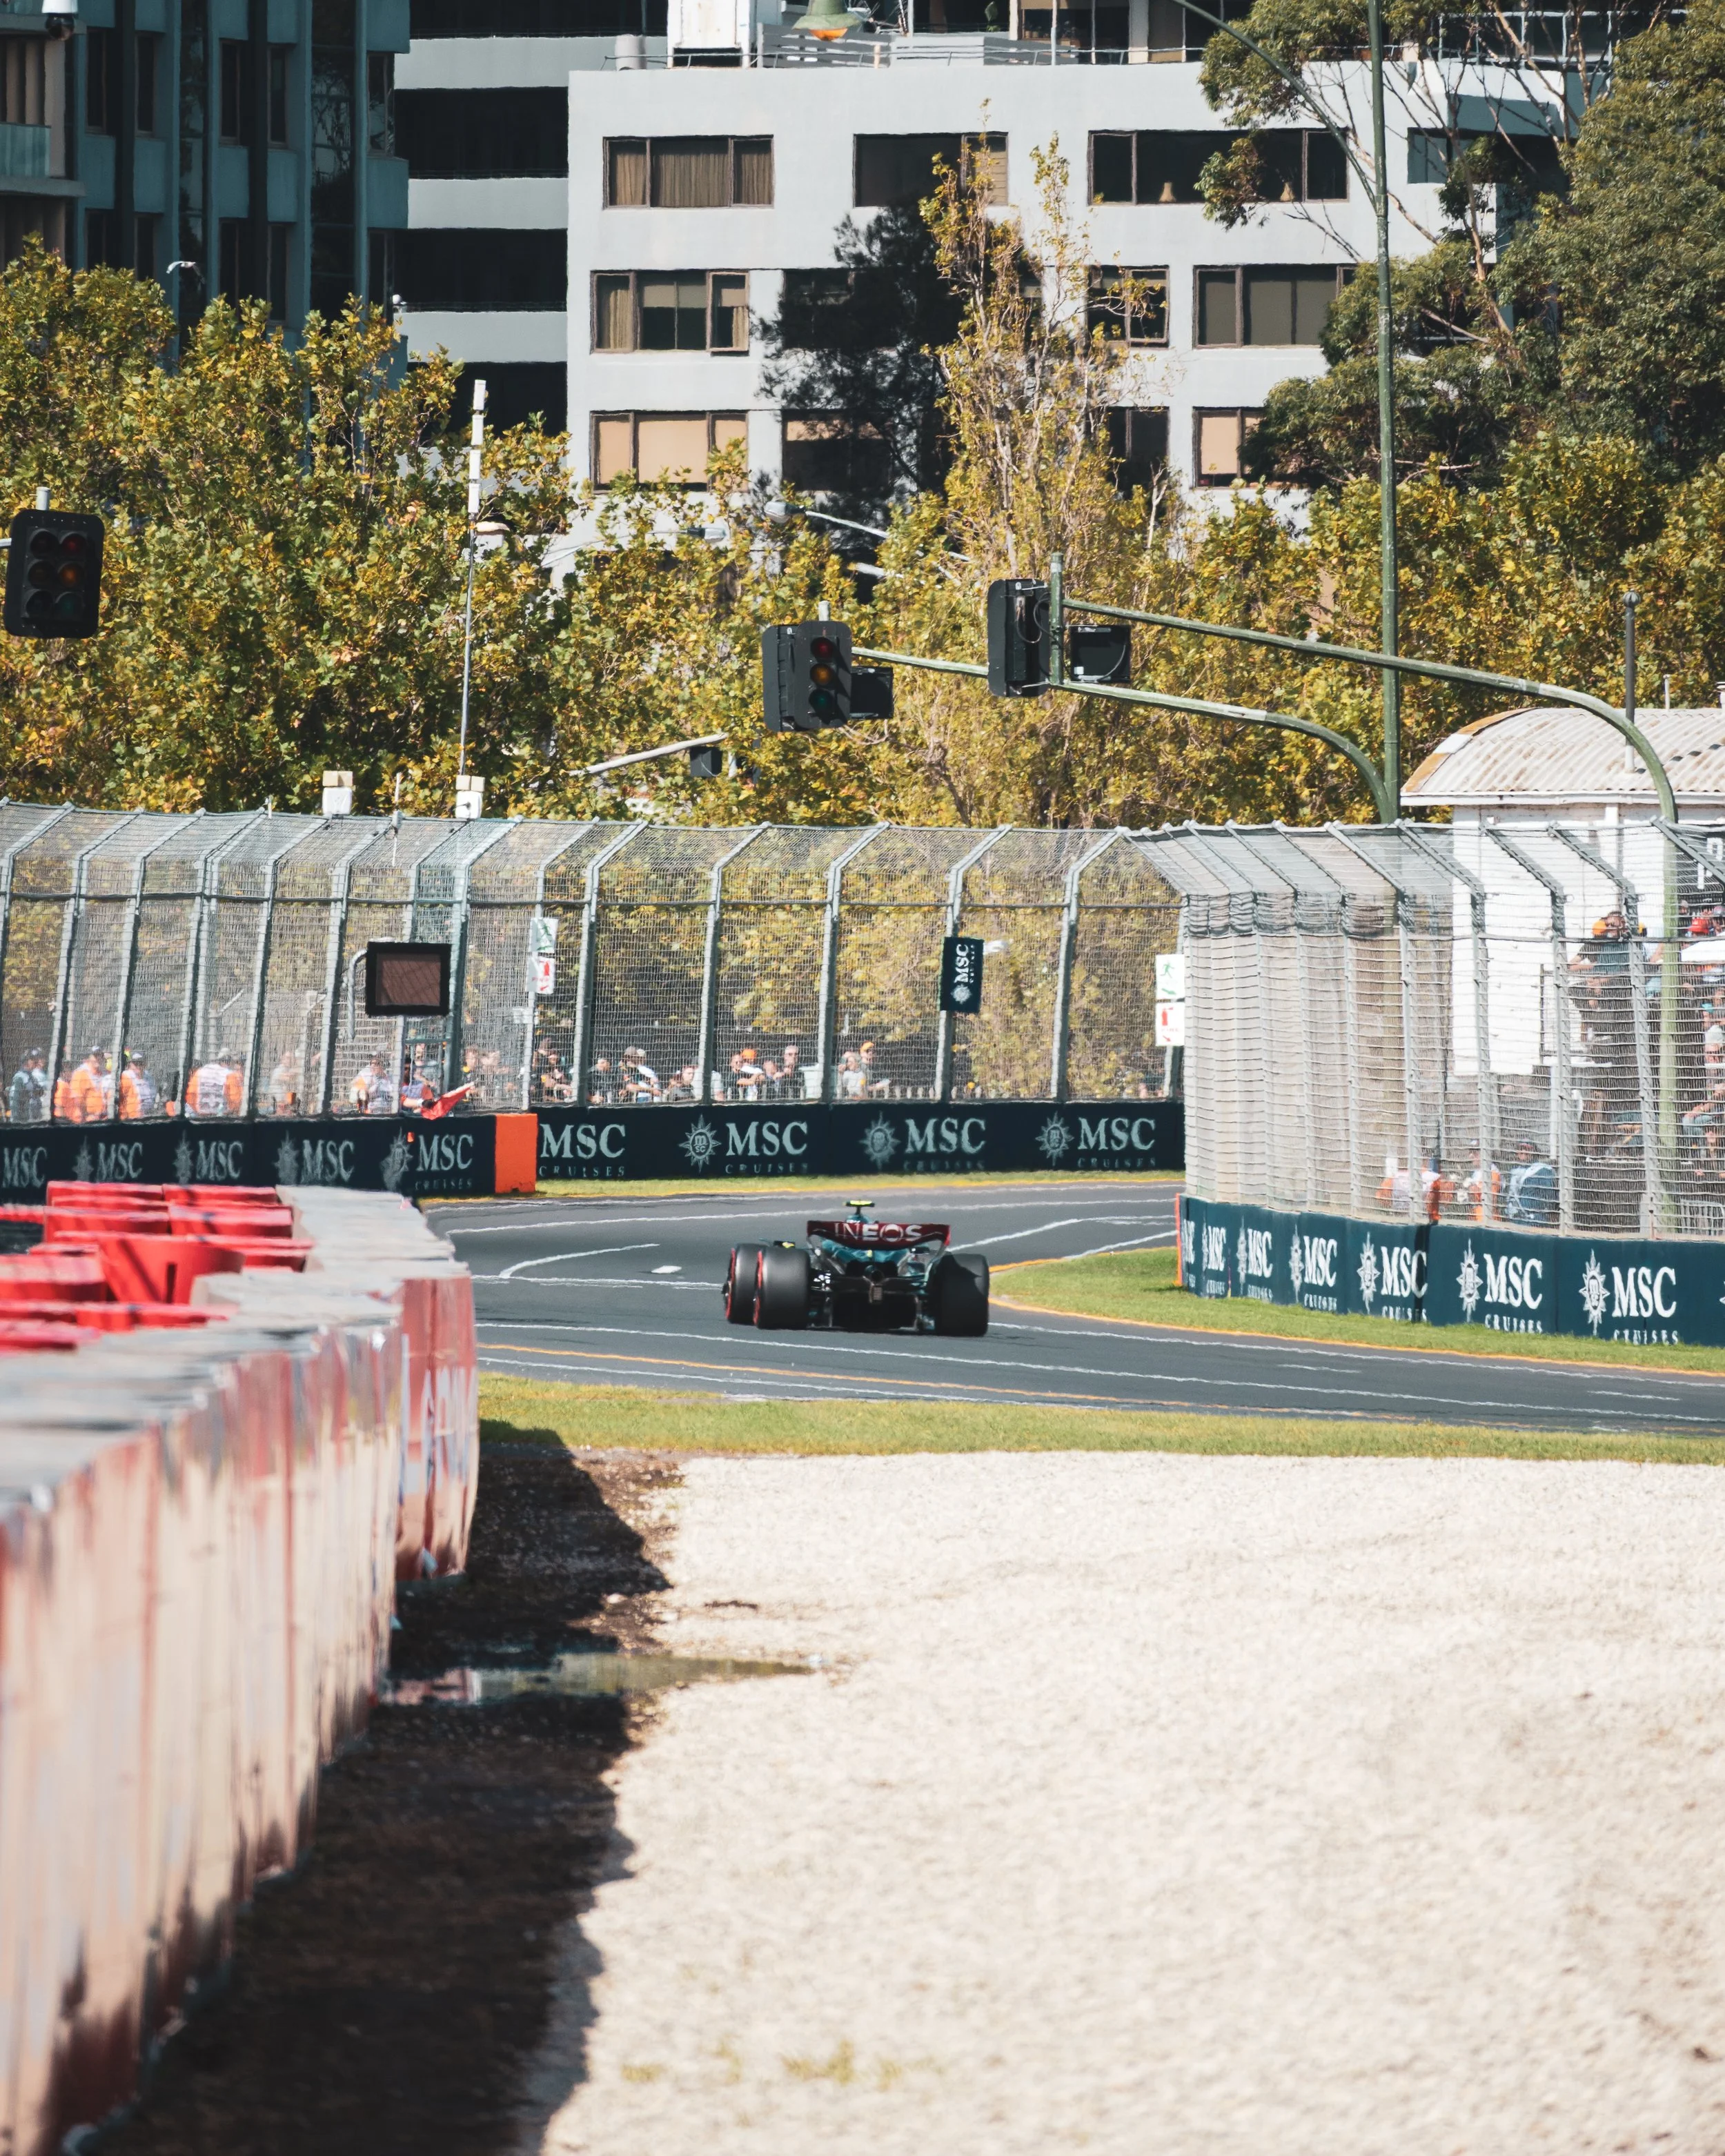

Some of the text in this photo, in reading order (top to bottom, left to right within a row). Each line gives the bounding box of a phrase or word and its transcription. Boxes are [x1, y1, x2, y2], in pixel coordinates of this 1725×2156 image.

[954, 943, 969, 983] MSC
[415, 1134, 474, 1171] MSC
[540, 1122, 626, 1159] MSC
[725, 1120, 808, 1156] MSC
[905, 1117, 986, 1154] MSC
[1077, 1117, 1156, 1151] MSC
[2, 1147, 47, 1188] MSC
[95, 1142, 143, 1183] MSC
[196, 1140, 244, 1181] MSC
[301, 1139, 354, 1184] MSC
[539, 1165, 624, 1178] CRUISES
[834, 1222, 923, 1242] INEOS
[1247, 1228, 1273, 1278] MSC
[1303, 1236, 1338, 1288] MSC
[1381, 1246, 1428, 1299] MSC
[1483, 1253, 1543, 1310] MSC
[1611, 1266, 1677, 1318] MSC
